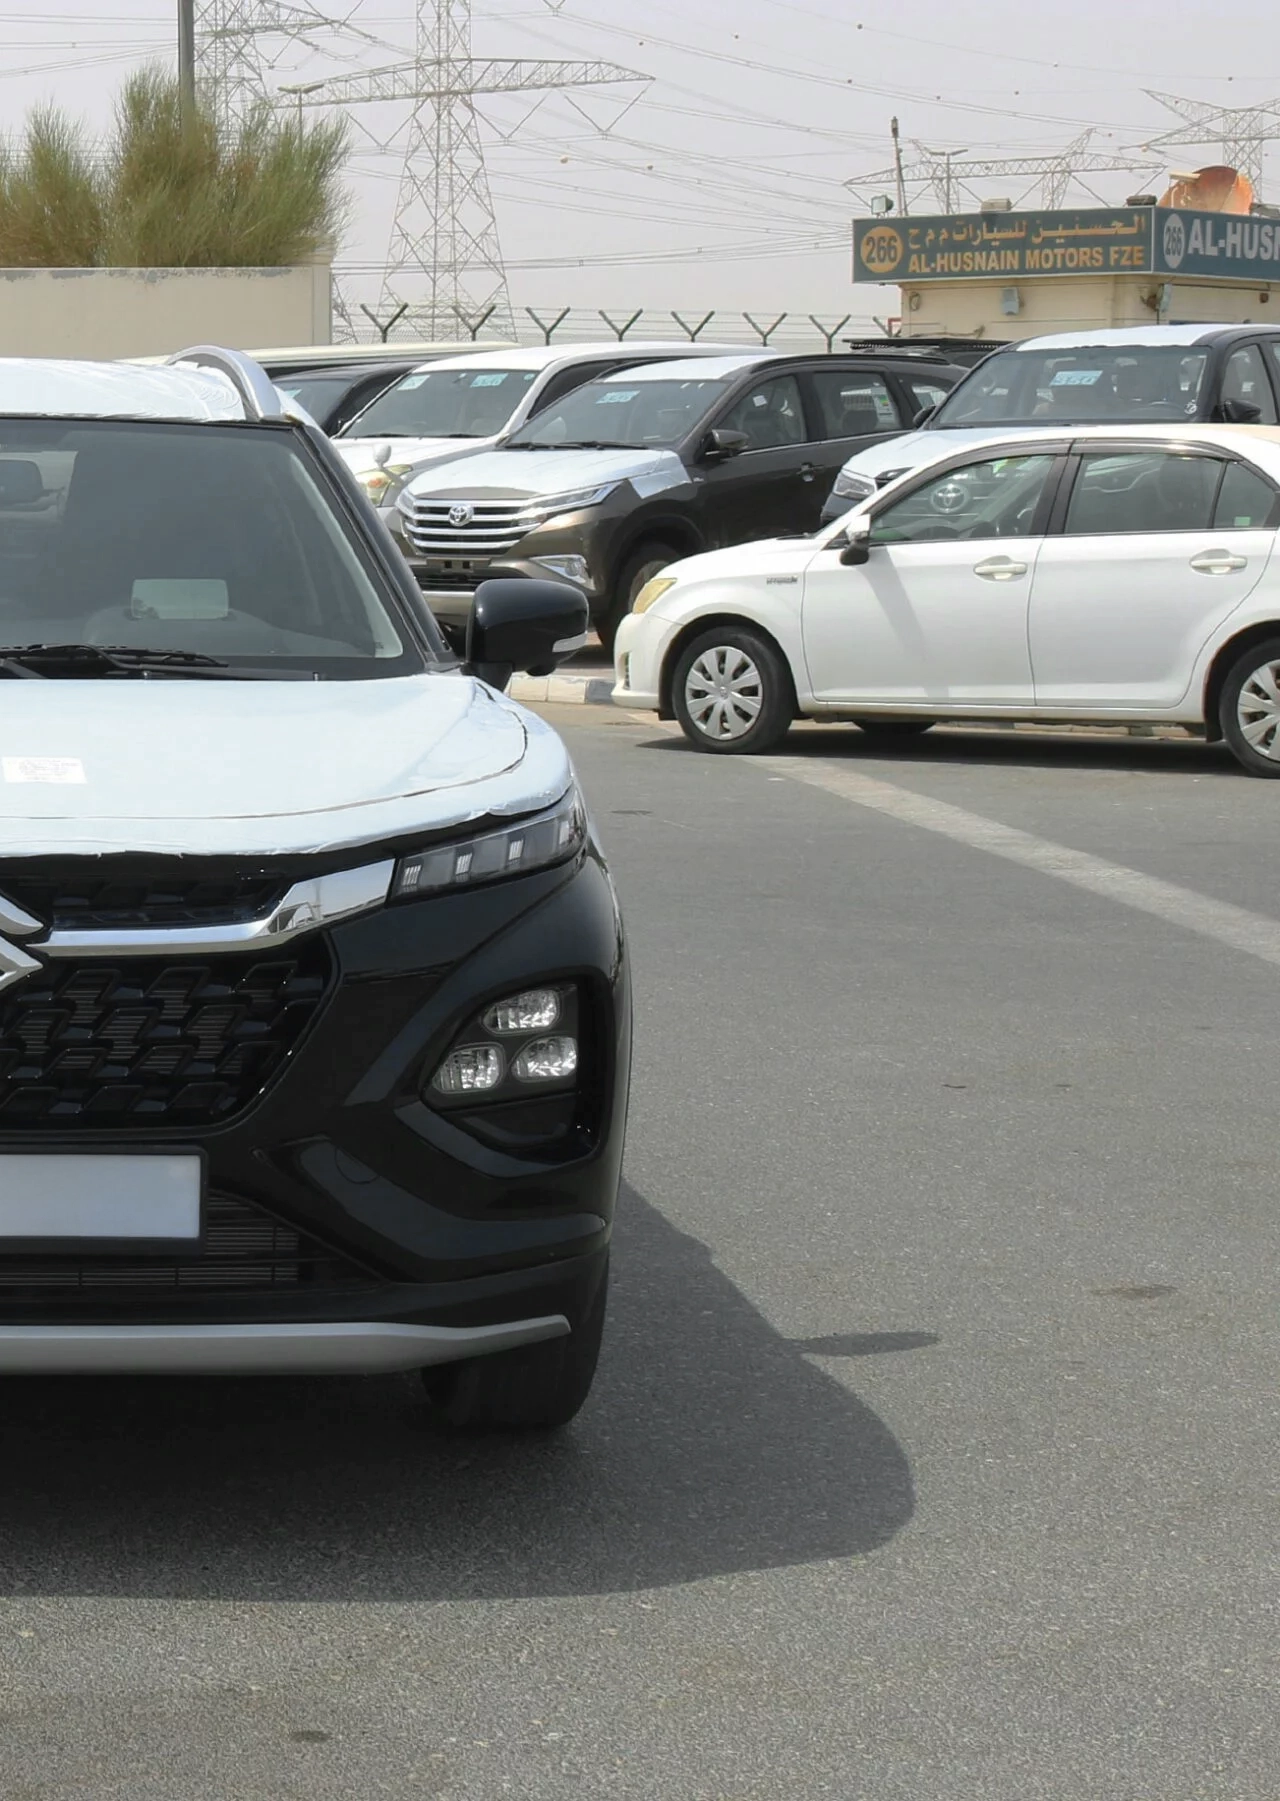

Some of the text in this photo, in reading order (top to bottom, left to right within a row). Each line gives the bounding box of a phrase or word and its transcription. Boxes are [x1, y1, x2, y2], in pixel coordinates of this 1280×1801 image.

[952, 220, 1028, 246] للسيارات
[1165, 225, 1183, 257] 266
[865, 235, 898, 264] 266
[908, 246, 1145, 273] AL-HUSNAIN MOTORS FZE
